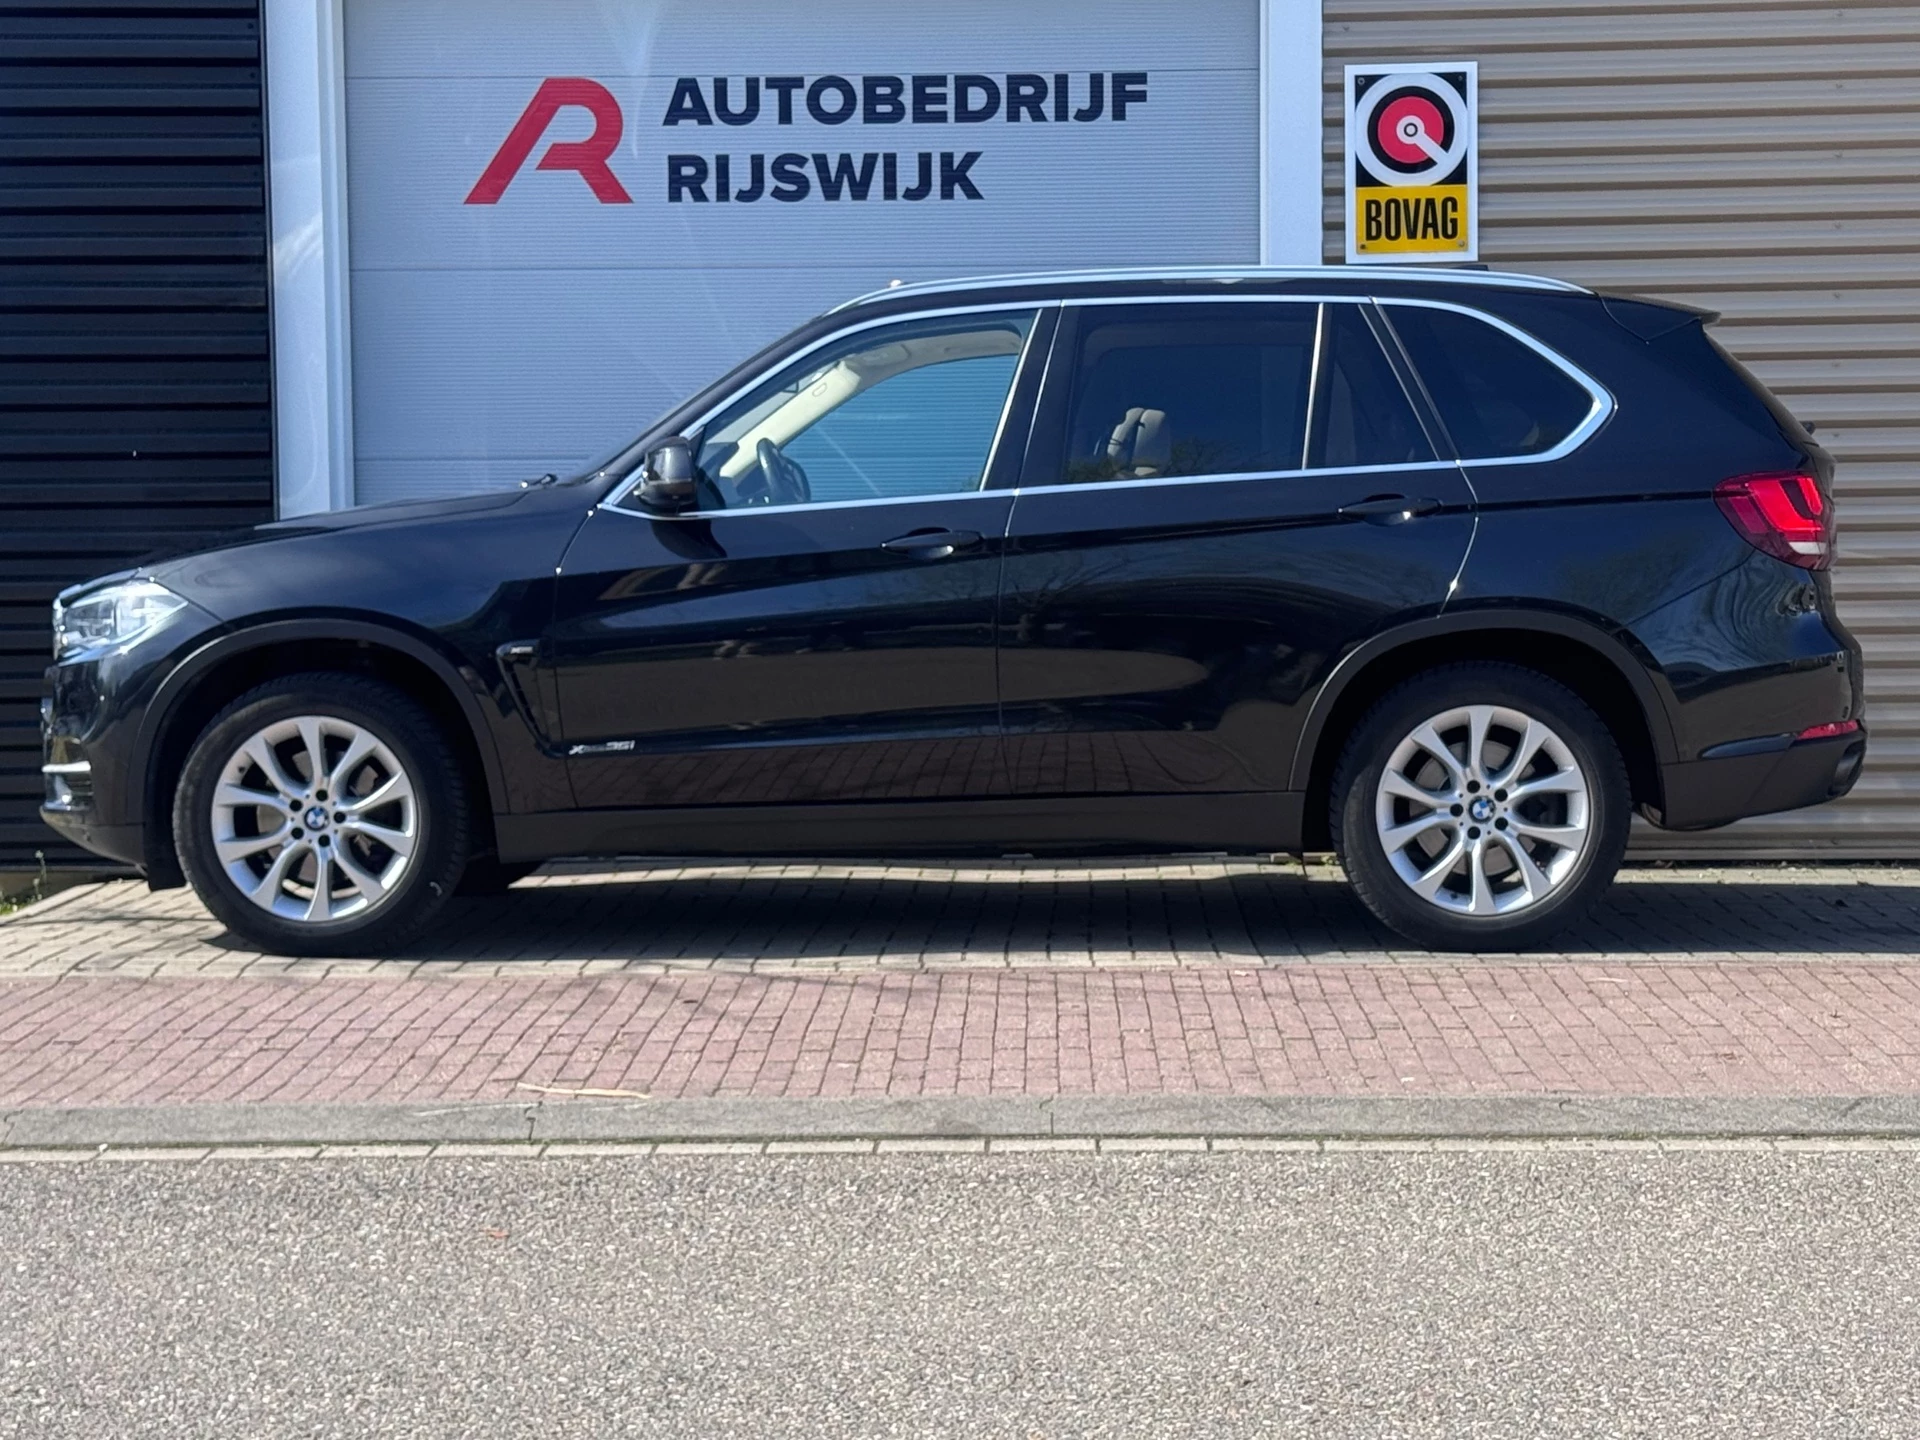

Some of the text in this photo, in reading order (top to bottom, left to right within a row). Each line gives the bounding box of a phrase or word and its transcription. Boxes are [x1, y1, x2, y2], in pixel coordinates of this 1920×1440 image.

[662, 72, 1148, 126] AUTOBEDRIJF
[667, 150, 986, 203] RIJSWIJK
[1365, 196, 1459, 241] BOVAG
